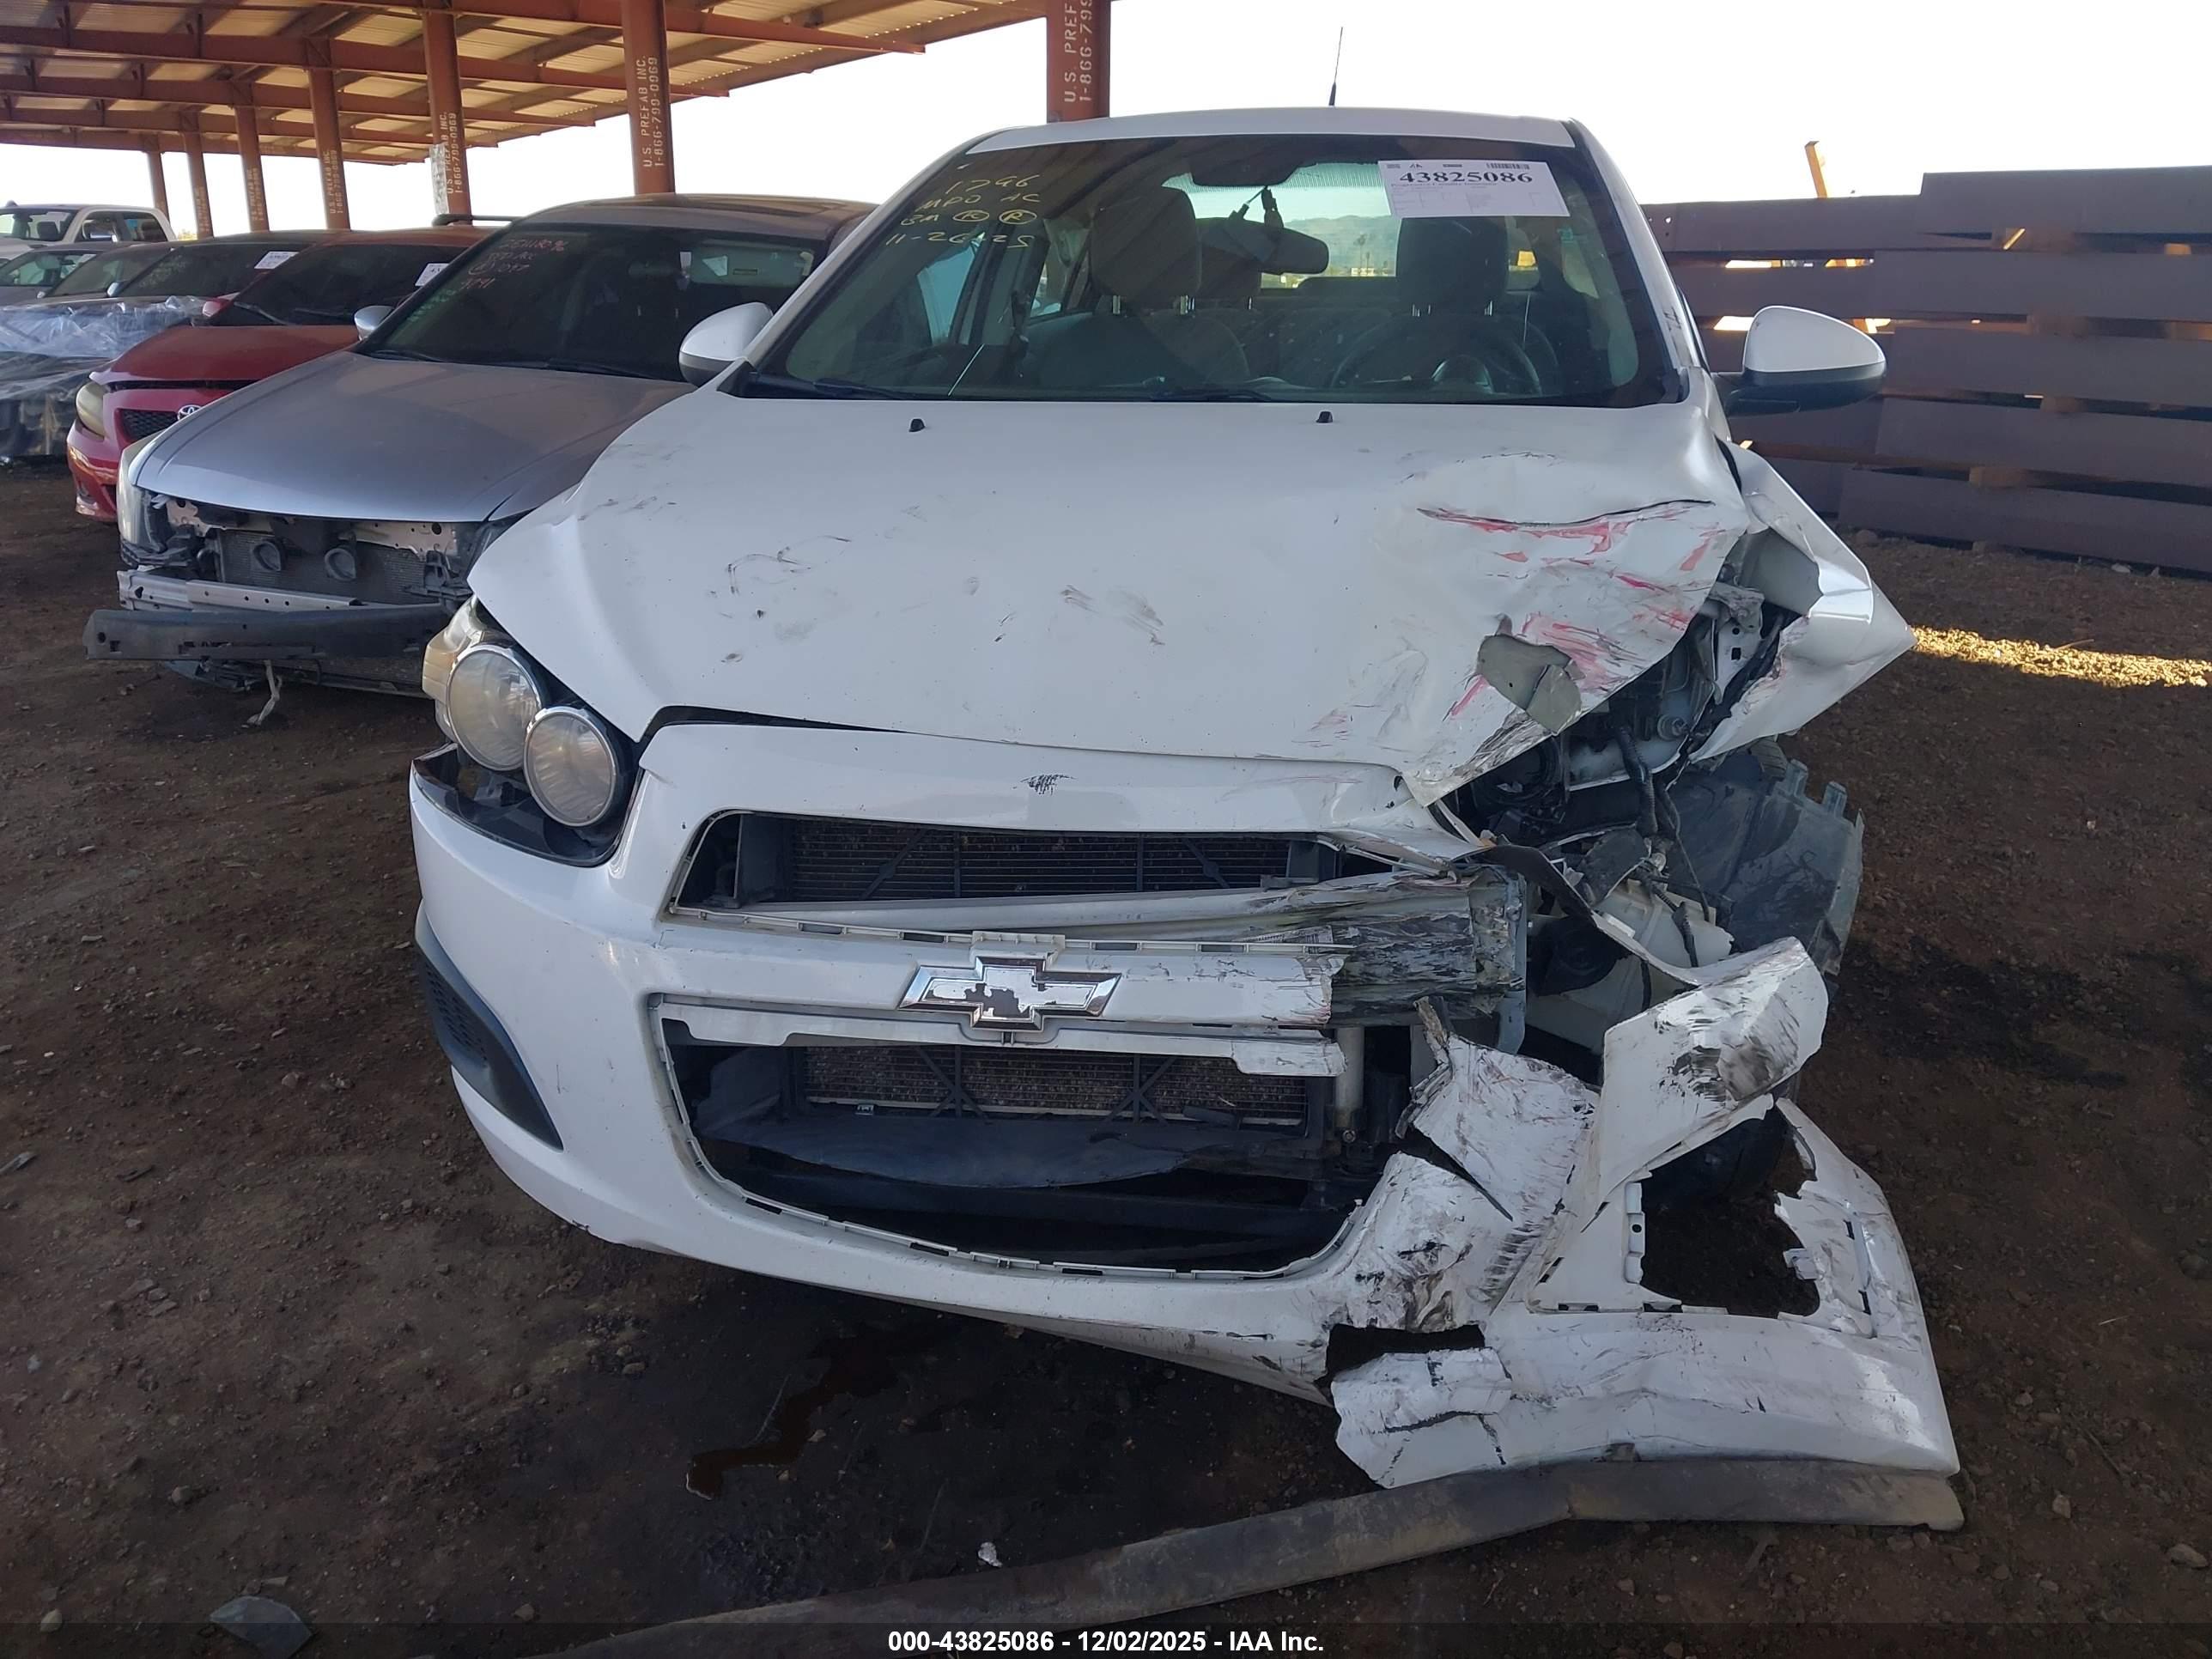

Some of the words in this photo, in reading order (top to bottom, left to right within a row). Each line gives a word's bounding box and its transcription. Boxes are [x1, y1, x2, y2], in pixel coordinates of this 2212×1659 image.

[636, 55, 647, 80] INC.
[638, 87, 650, 137] PREFAB
[1399, 171, 1534, 183] 43825086
